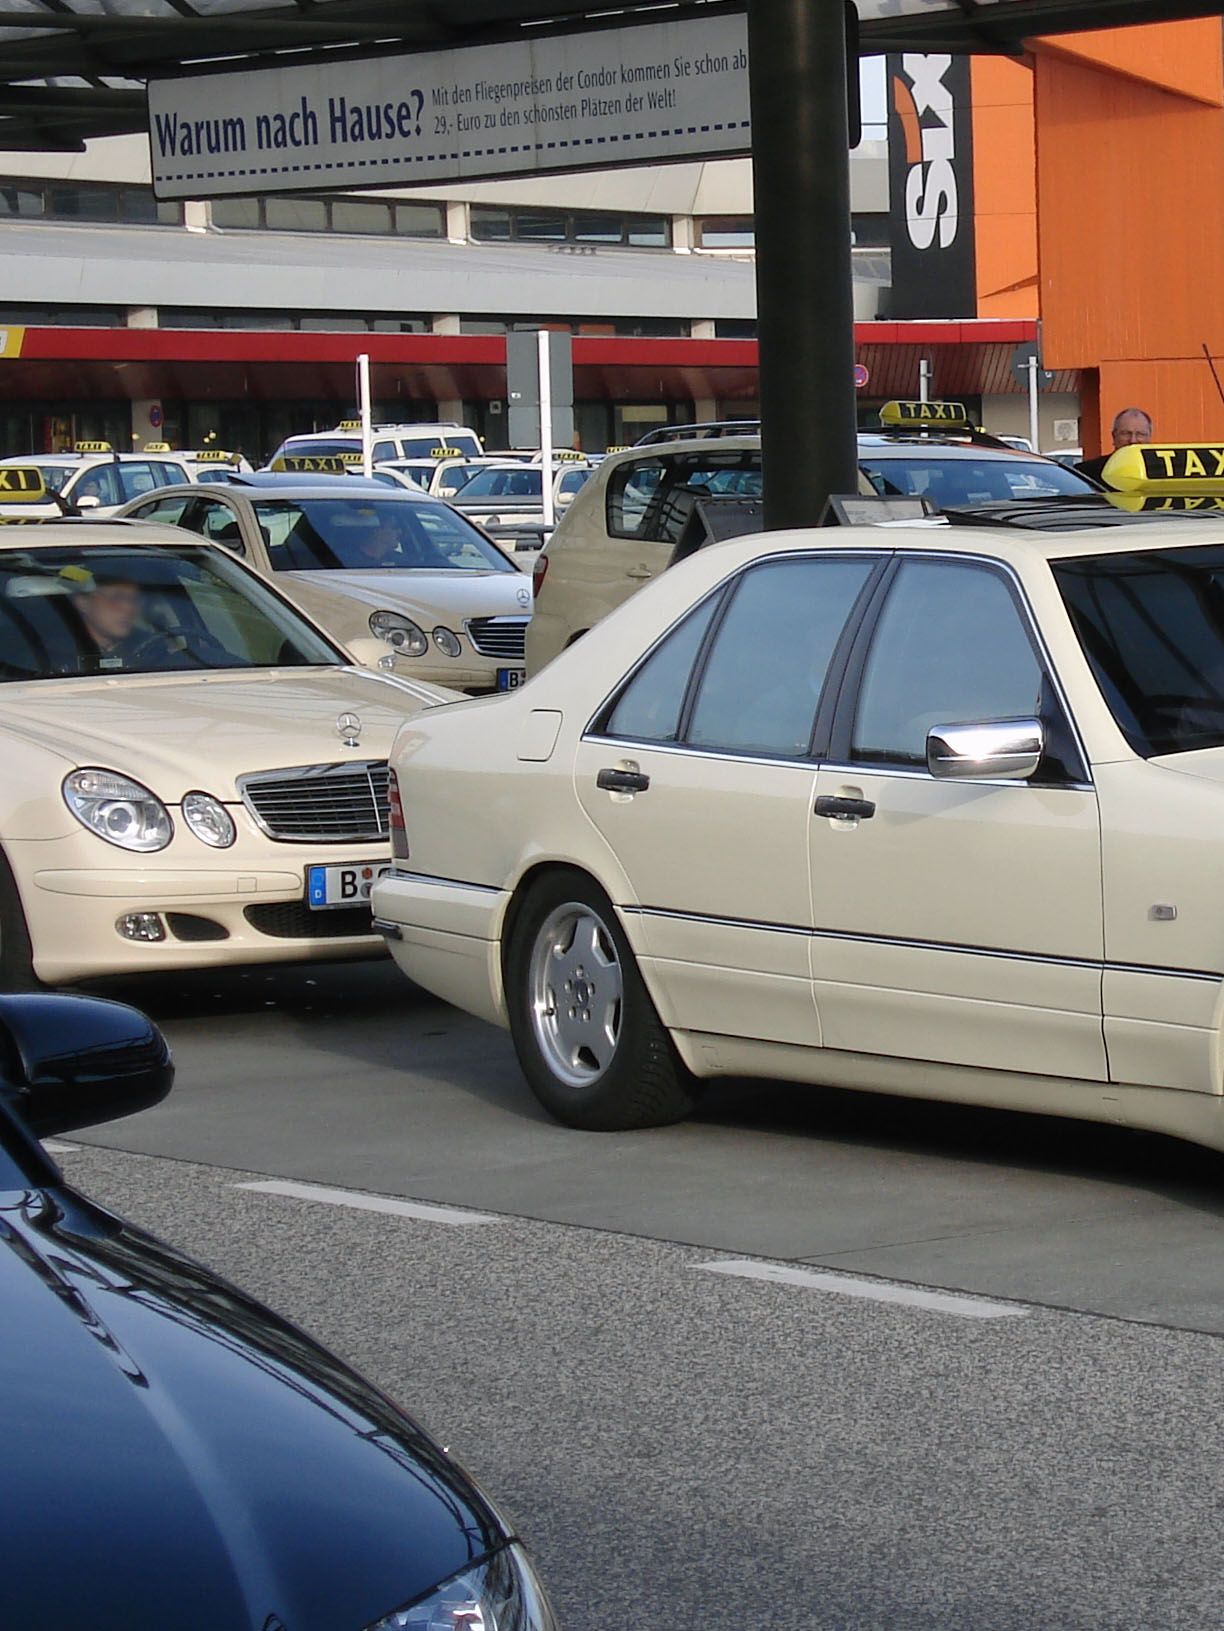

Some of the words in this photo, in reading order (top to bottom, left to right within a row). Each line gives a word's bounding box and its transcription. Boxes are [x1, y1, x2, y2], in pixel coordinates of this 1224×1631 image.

[432, 86, 449, 106] Mit
[452, 84, 472, 104] den
[556, 71, 574, 92] der
[577, 66, 617, 89] Condor
[620, 63, 671, 85] kommen
[673, 56, 691, 77] Sie
[694, 52, 729, 75] schon
[733, 48, 748, 70] ab
[155, 112, 246, 158] Warum
[256, 96, 319, 150] nach
[328, 89, 425, 144] Hause?
[457, 113, 481, 132] Euro
[484, 114, 497, 129] zu
[500, 107, 520, 127] den
[523, 103, 577, 125] schönsten
[625, 92, 644, 113] der
[647, 87, 677, 110] Welt!
[905, 403, 956, 419] TAXI
[290, 458, 338, 472] TAXI
[509, 672, 519, 688] B
[341, 870, 359, 899] B
